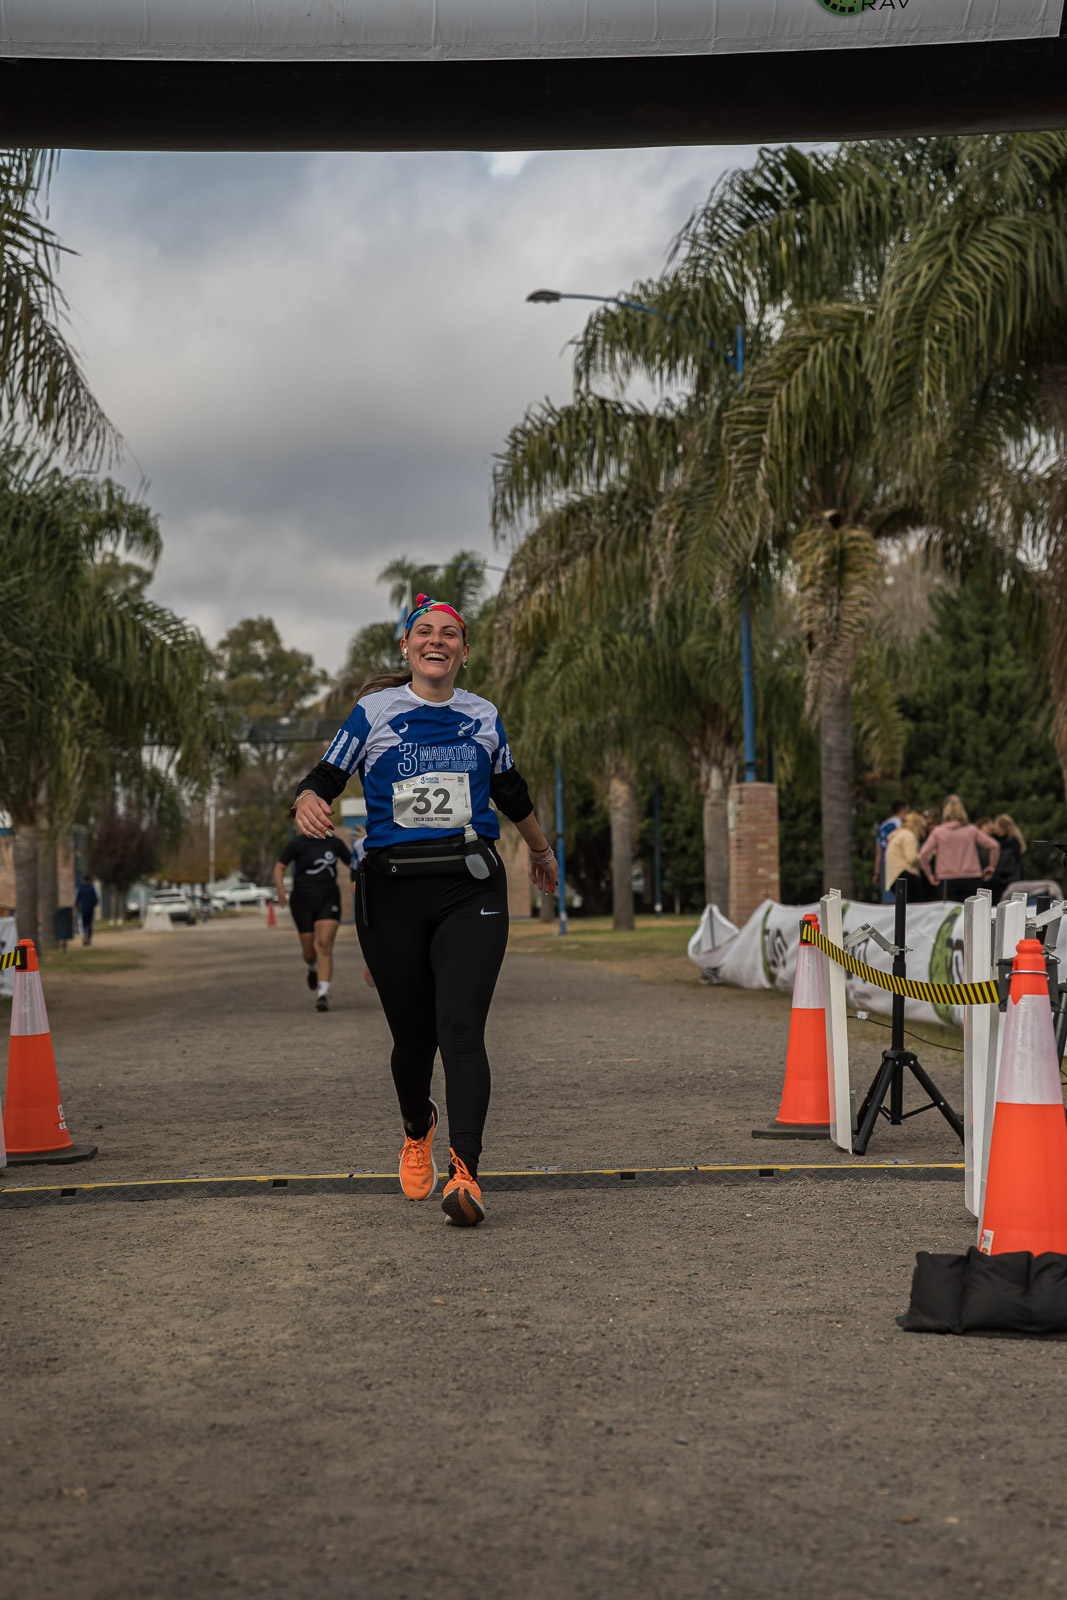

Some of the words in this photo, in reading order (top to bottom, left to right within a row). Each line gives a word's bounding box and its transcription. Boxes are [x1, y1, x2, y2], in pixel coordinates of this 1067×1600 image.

[398, 742, 418, 777] 3
[419, 743, 478, 761] MARATÓN
[412, 787, 453, 815] 32
